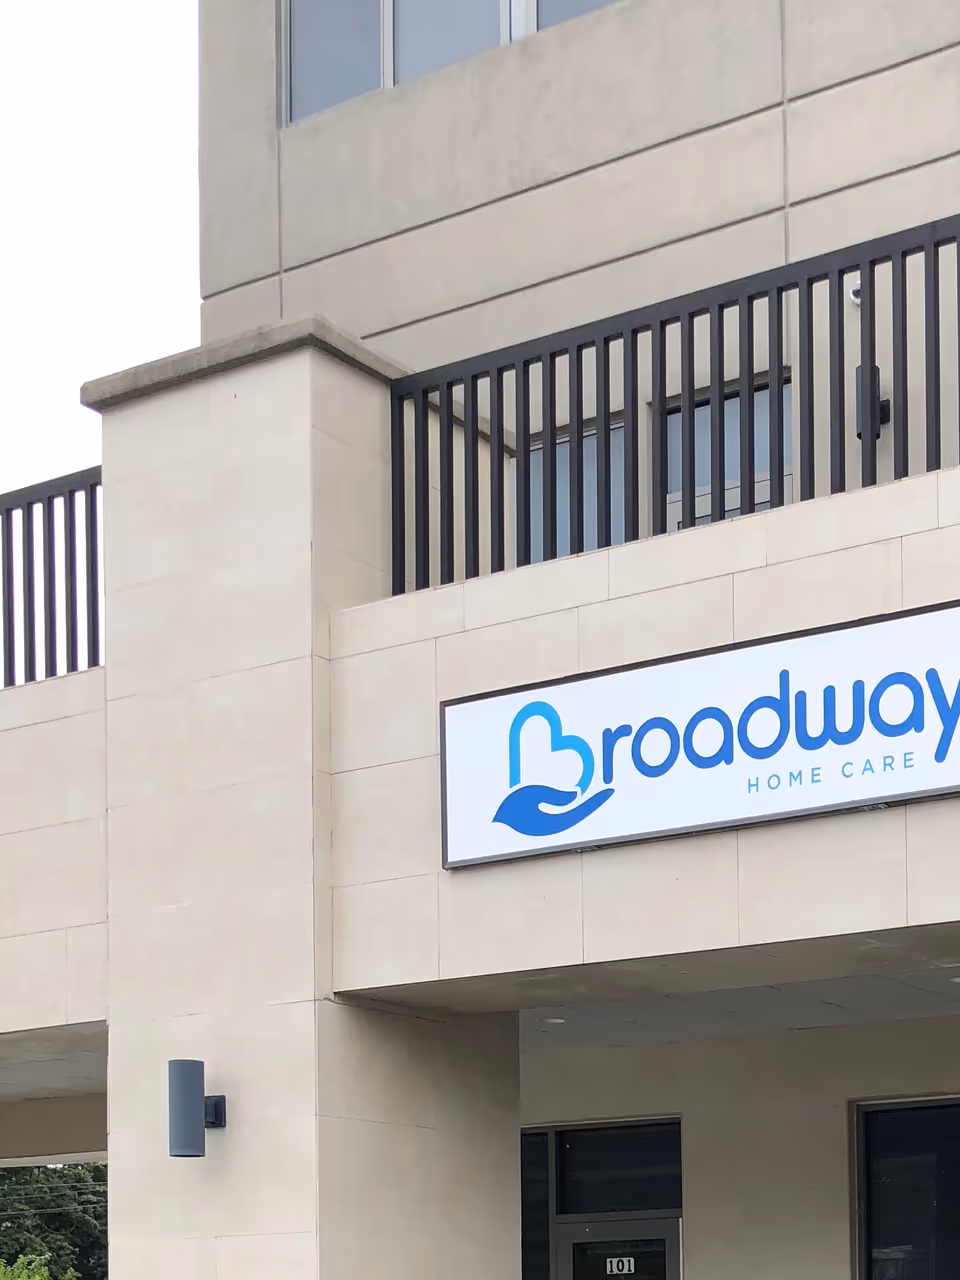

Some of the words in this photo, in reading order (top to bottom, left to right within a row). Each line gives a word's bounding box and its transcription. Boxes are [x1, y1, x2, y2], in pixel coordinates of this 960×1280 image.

[747, 766, 822, 794] HOME
[841, 751, 915, 779] CARE
[608, 1258, 632, 1274] 101
